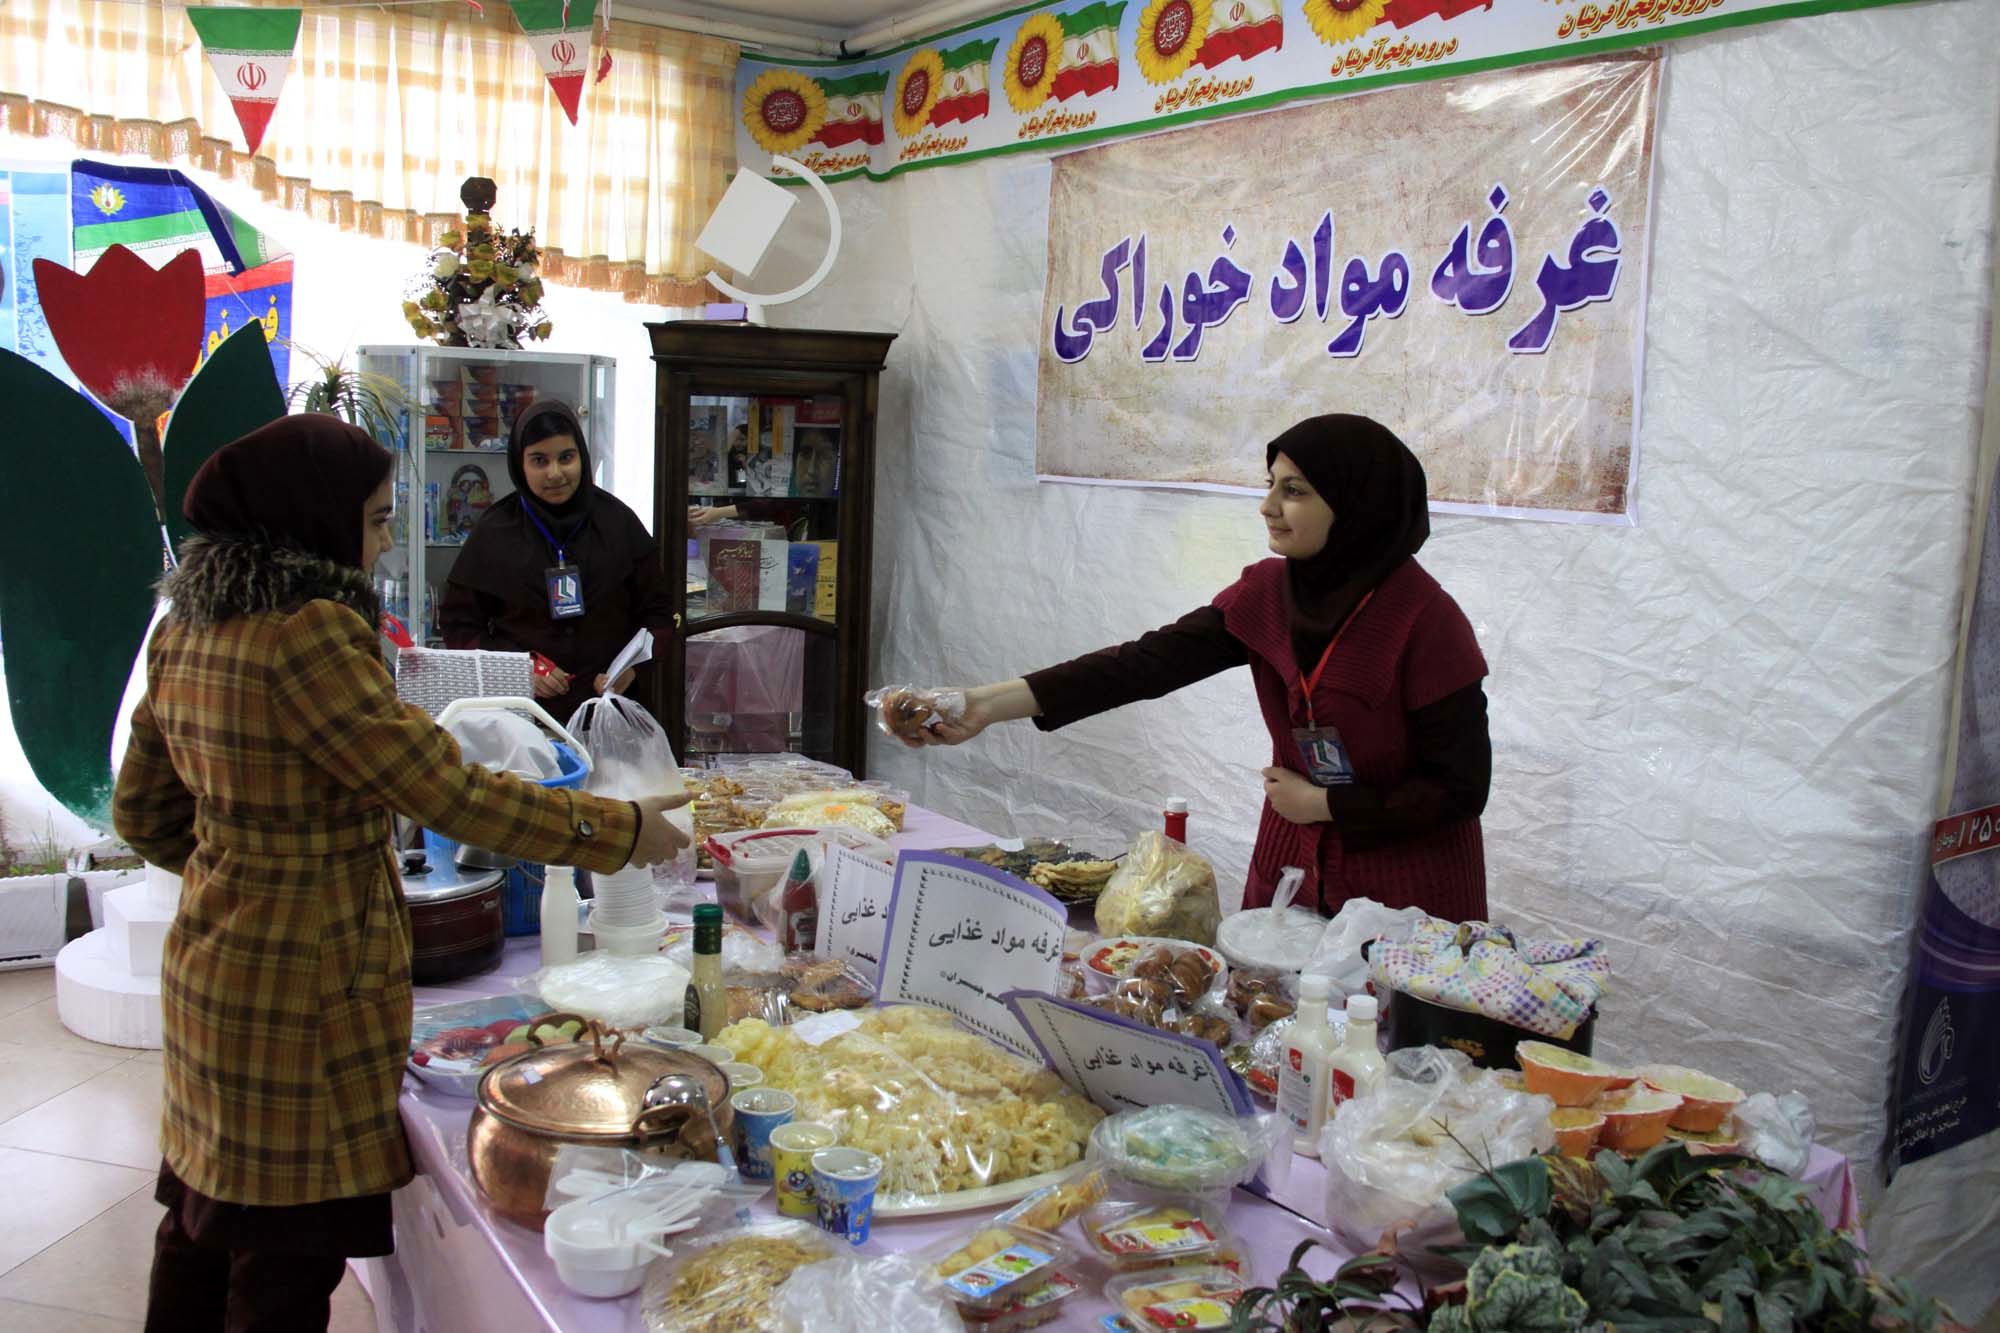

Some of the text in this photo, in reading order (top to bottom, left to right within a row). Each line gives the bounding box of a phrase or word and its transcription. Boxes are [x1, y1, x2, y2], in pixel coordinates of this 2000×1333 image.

[1416, 38, 1459, 61] درود
[1222, 75, 1254, 97] درود
[1073, 110, 1097, 128] درود
[1053, 184, 1623, 362] غرفه مواد خوراکی
[841, 897, 876, 925] غذایی
[929, 917, 1060, 963] غرفه مواد غذایی
[1082, 1047, 1209, 1082] غرفه مواد غذایی
